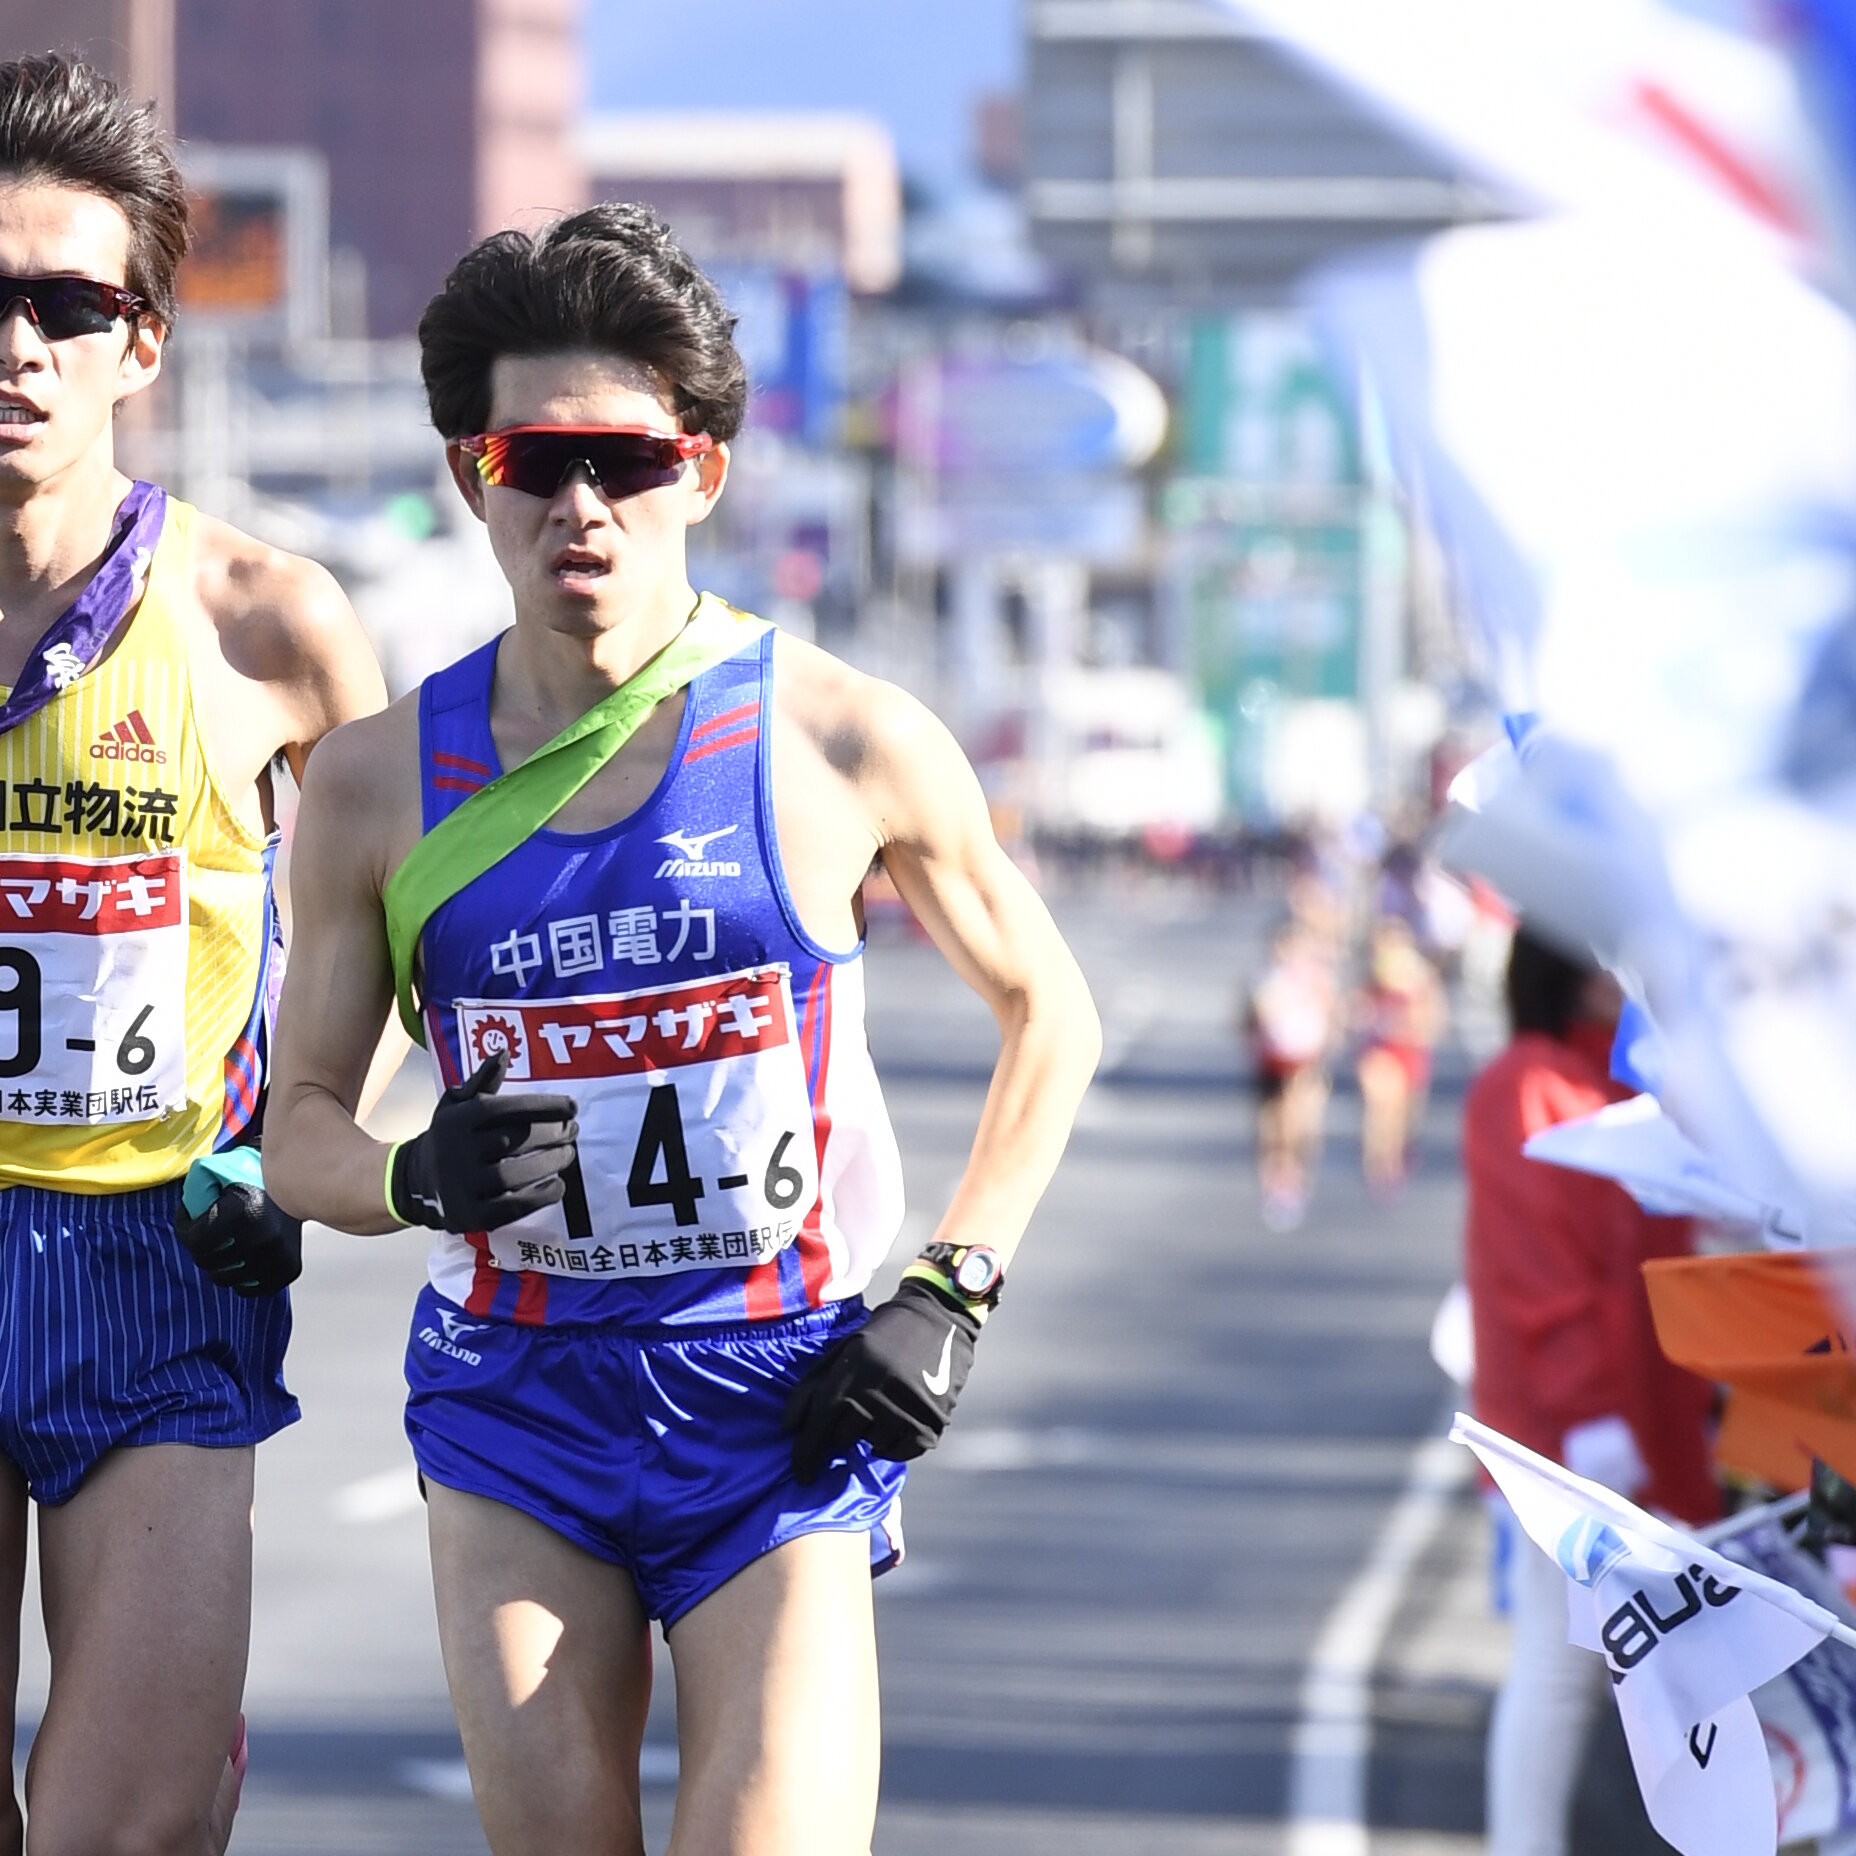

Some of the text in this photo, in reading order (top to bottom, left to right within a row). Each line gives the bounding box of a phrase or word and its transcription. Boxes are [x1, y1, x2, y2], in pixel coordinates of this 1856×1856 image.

[89, 742, 166, 764] adidas
[490, 899, 716, 988] 中国電力
[538, 994, 773, 1064] ヤマザキ
